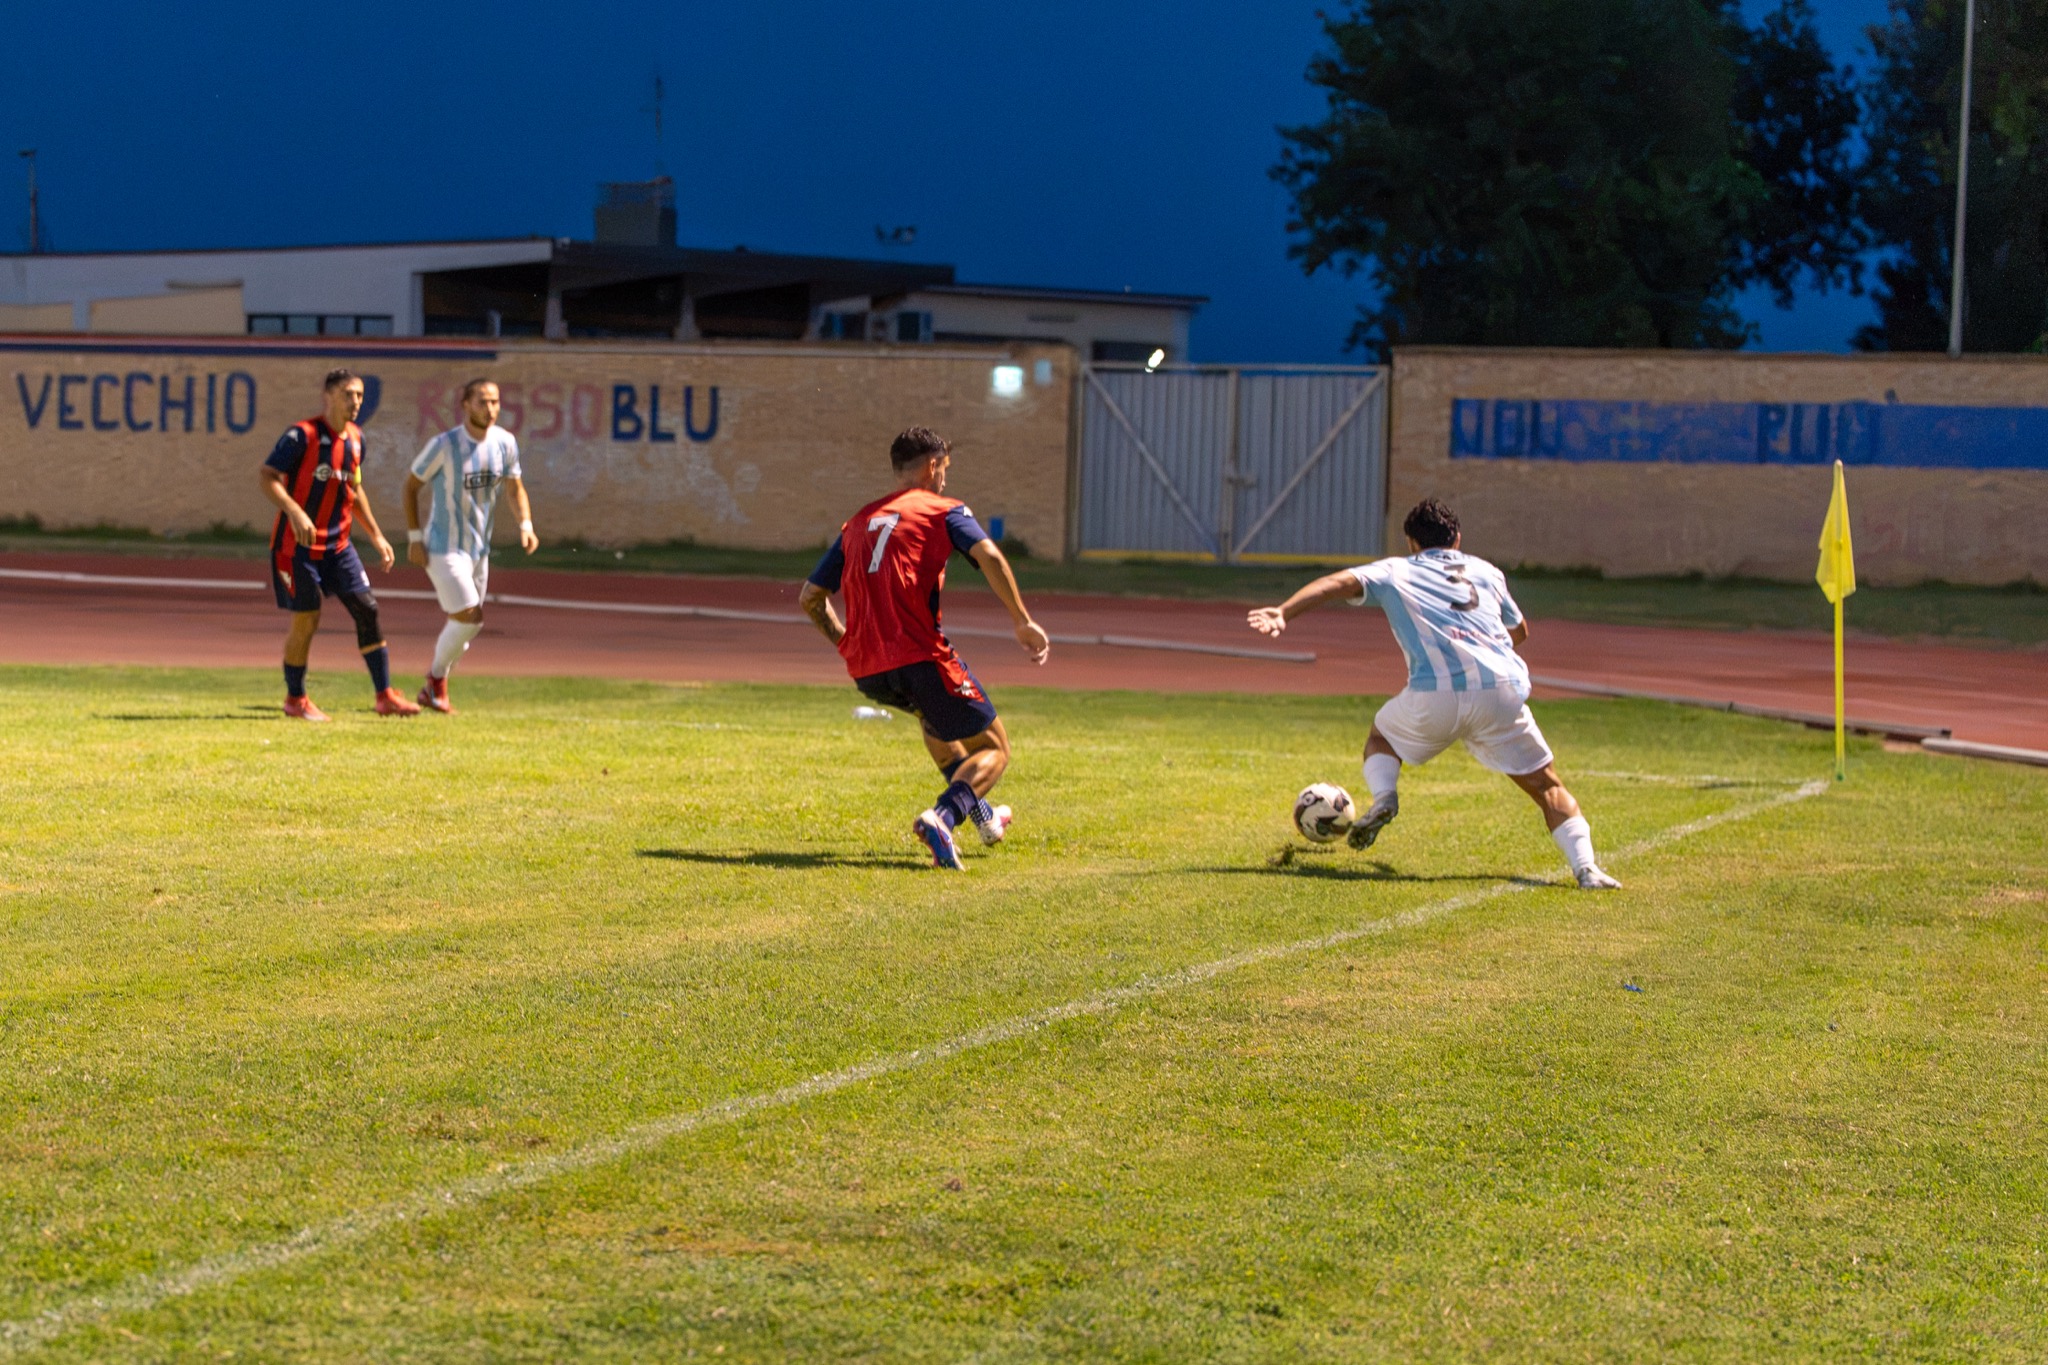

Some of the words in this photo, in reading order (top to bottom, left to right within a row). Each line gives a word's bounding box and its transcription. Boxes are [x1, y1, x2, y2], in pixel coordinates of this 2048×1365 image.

[15, 371, 258, 434] VECCHIO
[867, 513, 900, 574] 7
[1444, 564, 1479, 612] 3
